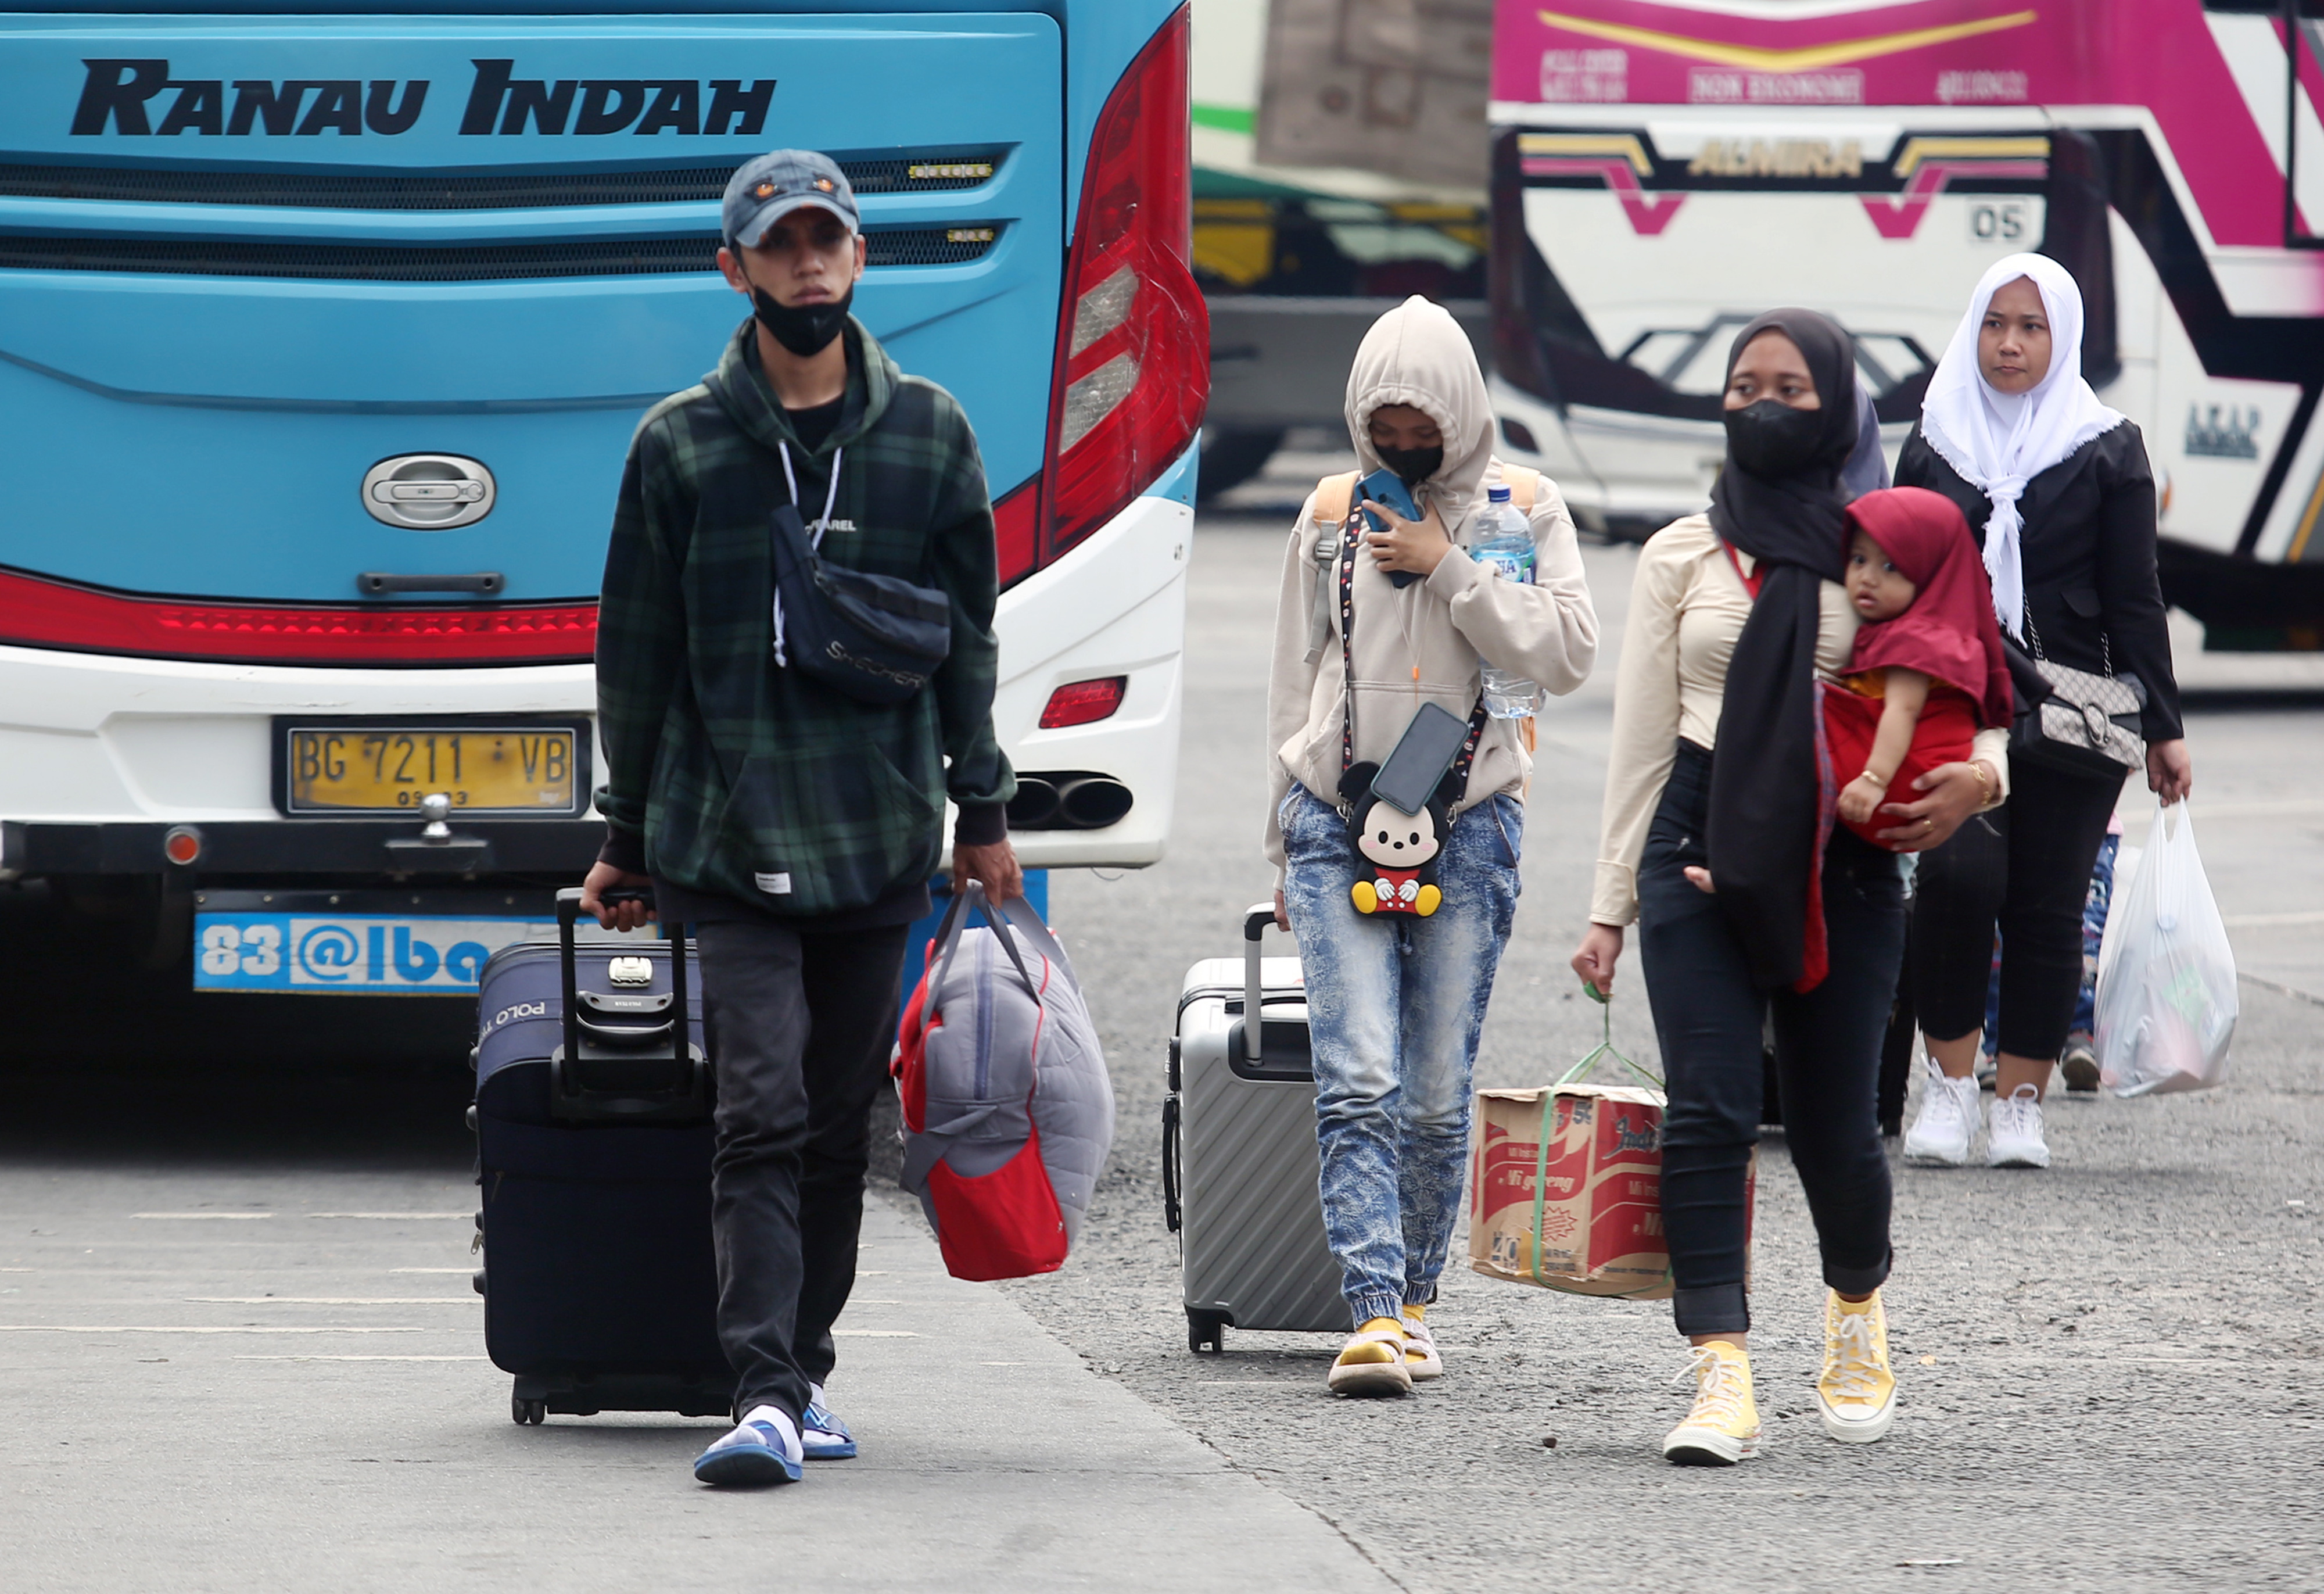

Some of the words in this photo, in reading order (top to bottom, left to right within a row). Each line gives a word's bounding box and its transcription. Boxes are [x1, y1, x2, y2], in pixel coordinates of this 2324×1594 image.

[69, 59, 430, 136] RANAU
[458, 59, 777, 136] INDAH
[1973, 205, 2022, 240] 05
[299, 736, 346, 782] BG
[364, 736, 461, 783] 7211
[521, 737, 566, 783] VB
[201, 924, 281, 976] 83
[496, 1002, 545, 1025] POLO
